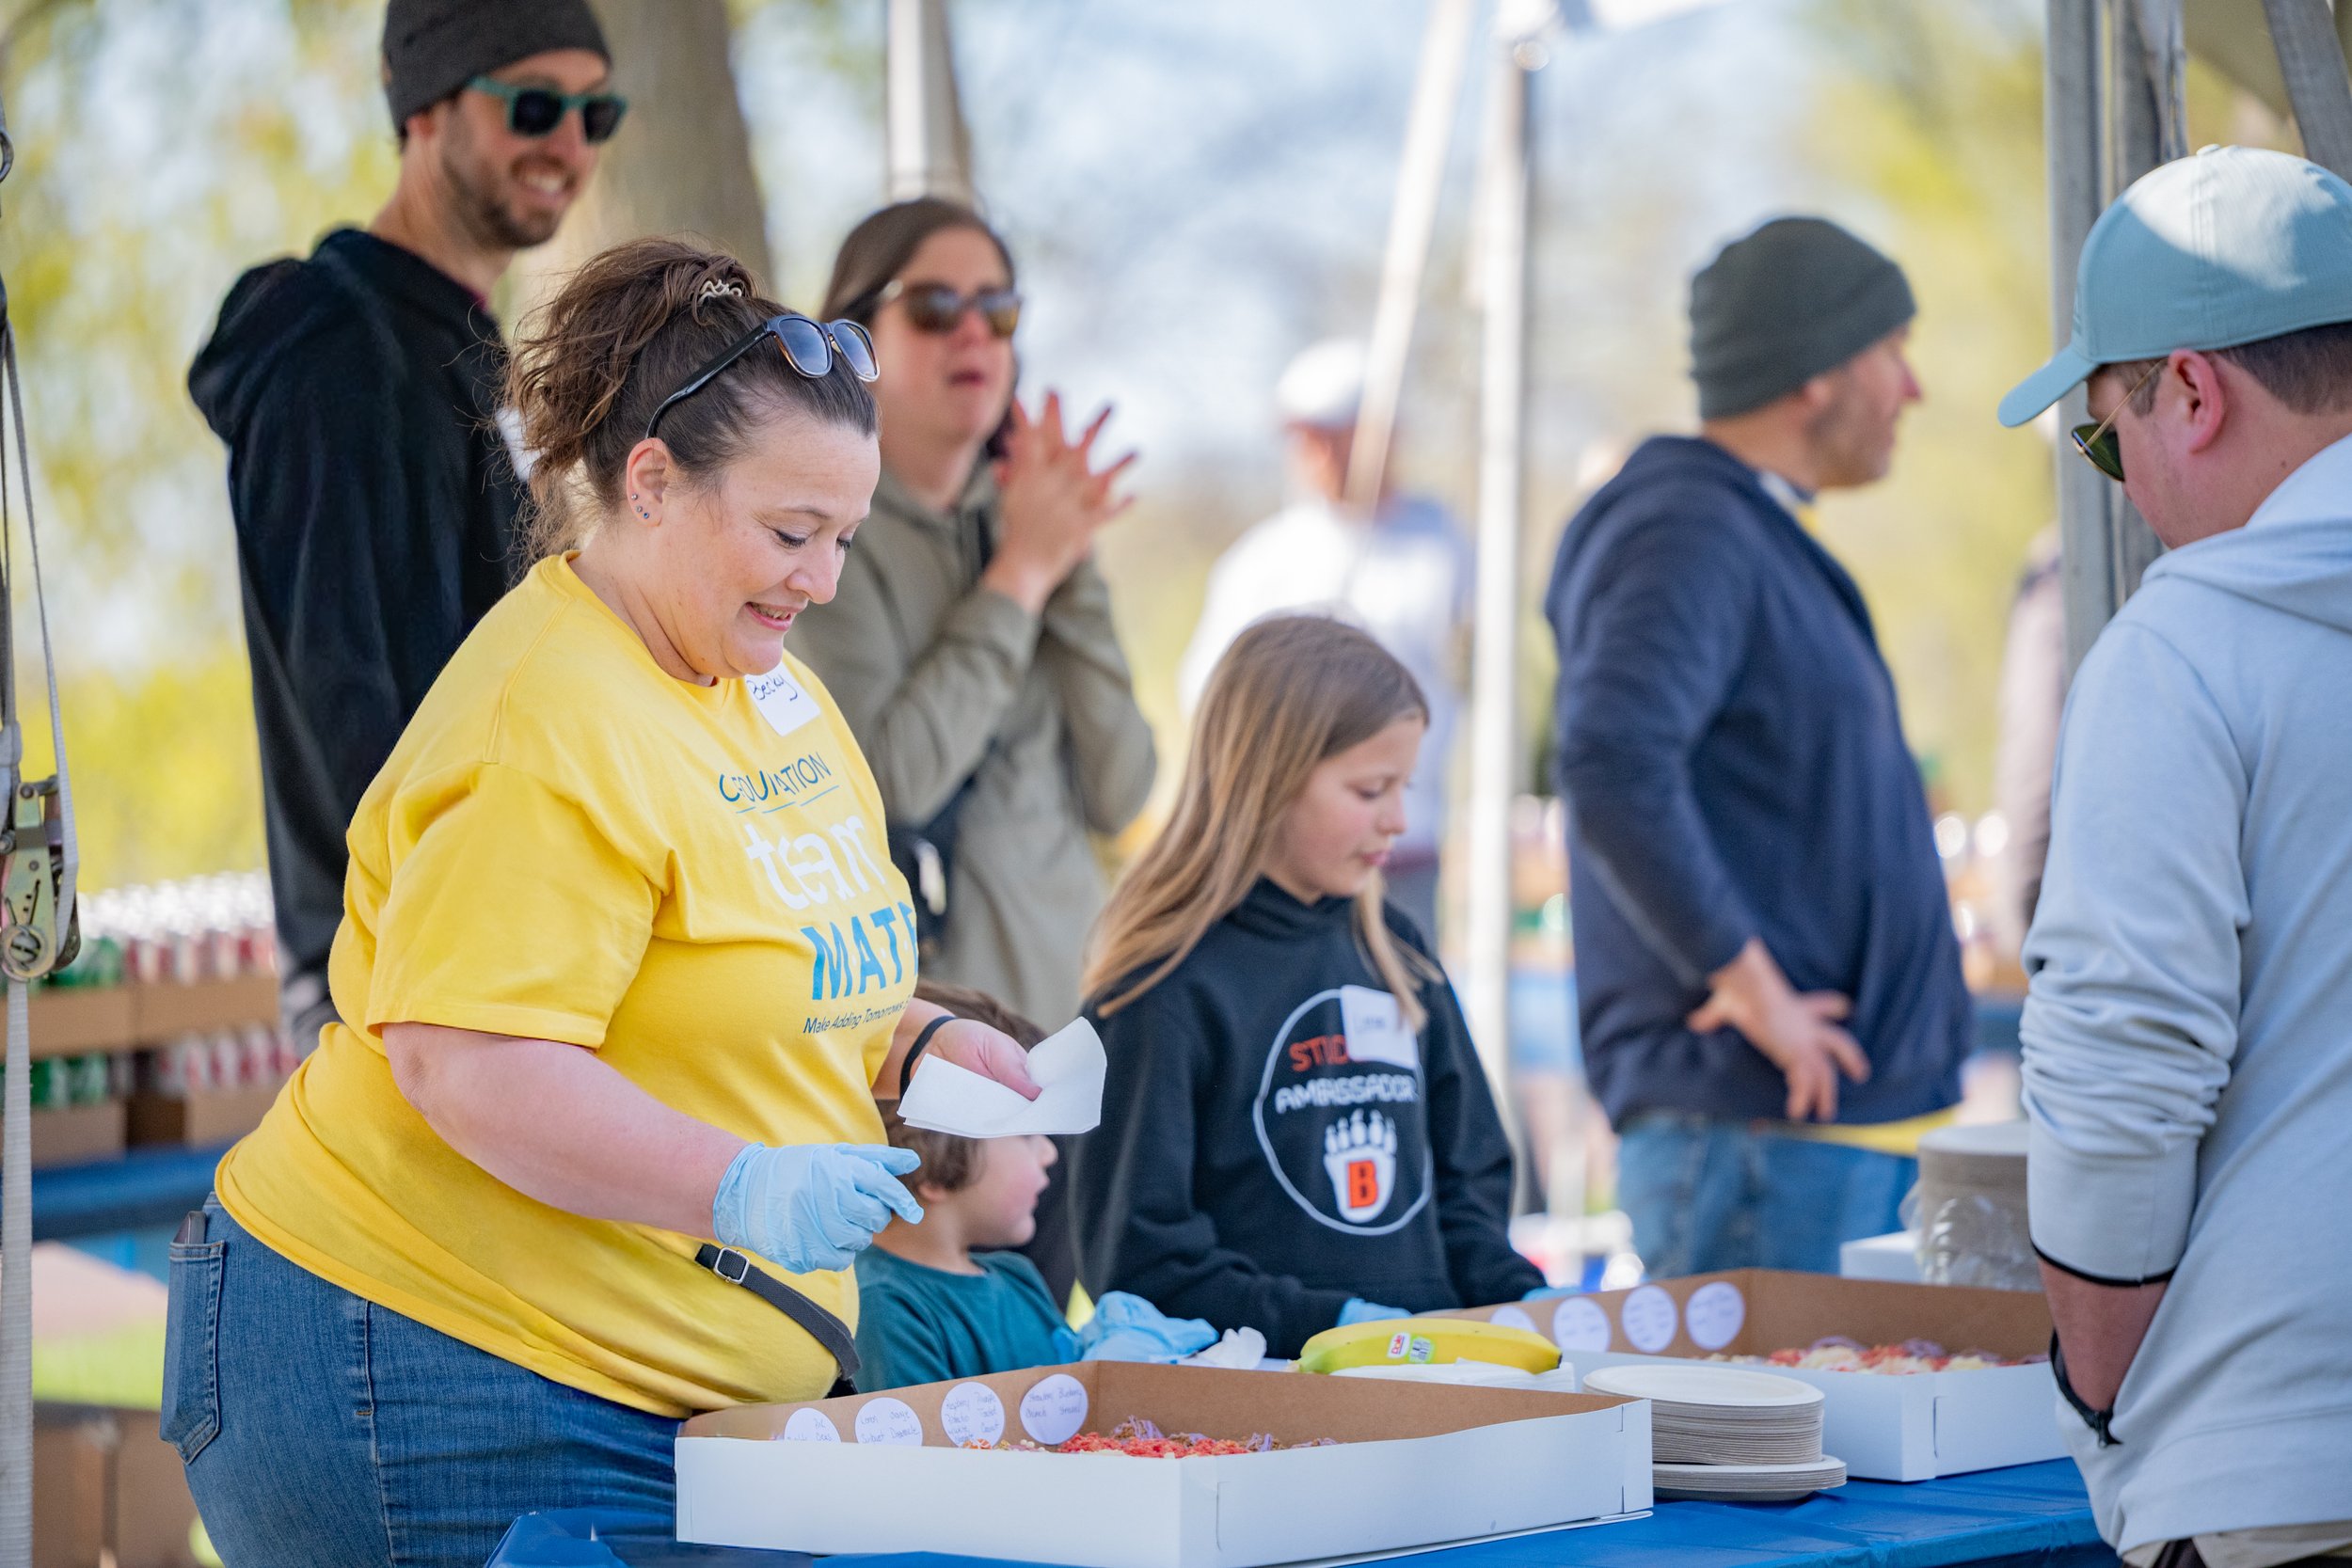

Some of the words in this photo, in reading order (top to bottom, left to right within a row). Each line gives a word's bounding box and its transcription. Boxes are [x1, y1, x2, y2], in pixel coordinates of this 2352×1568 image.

[802, 1015, 831, 1035] Make
[830, 1011, 863, 1030] Adding
[1348, 1158, 1379, 1210] B
